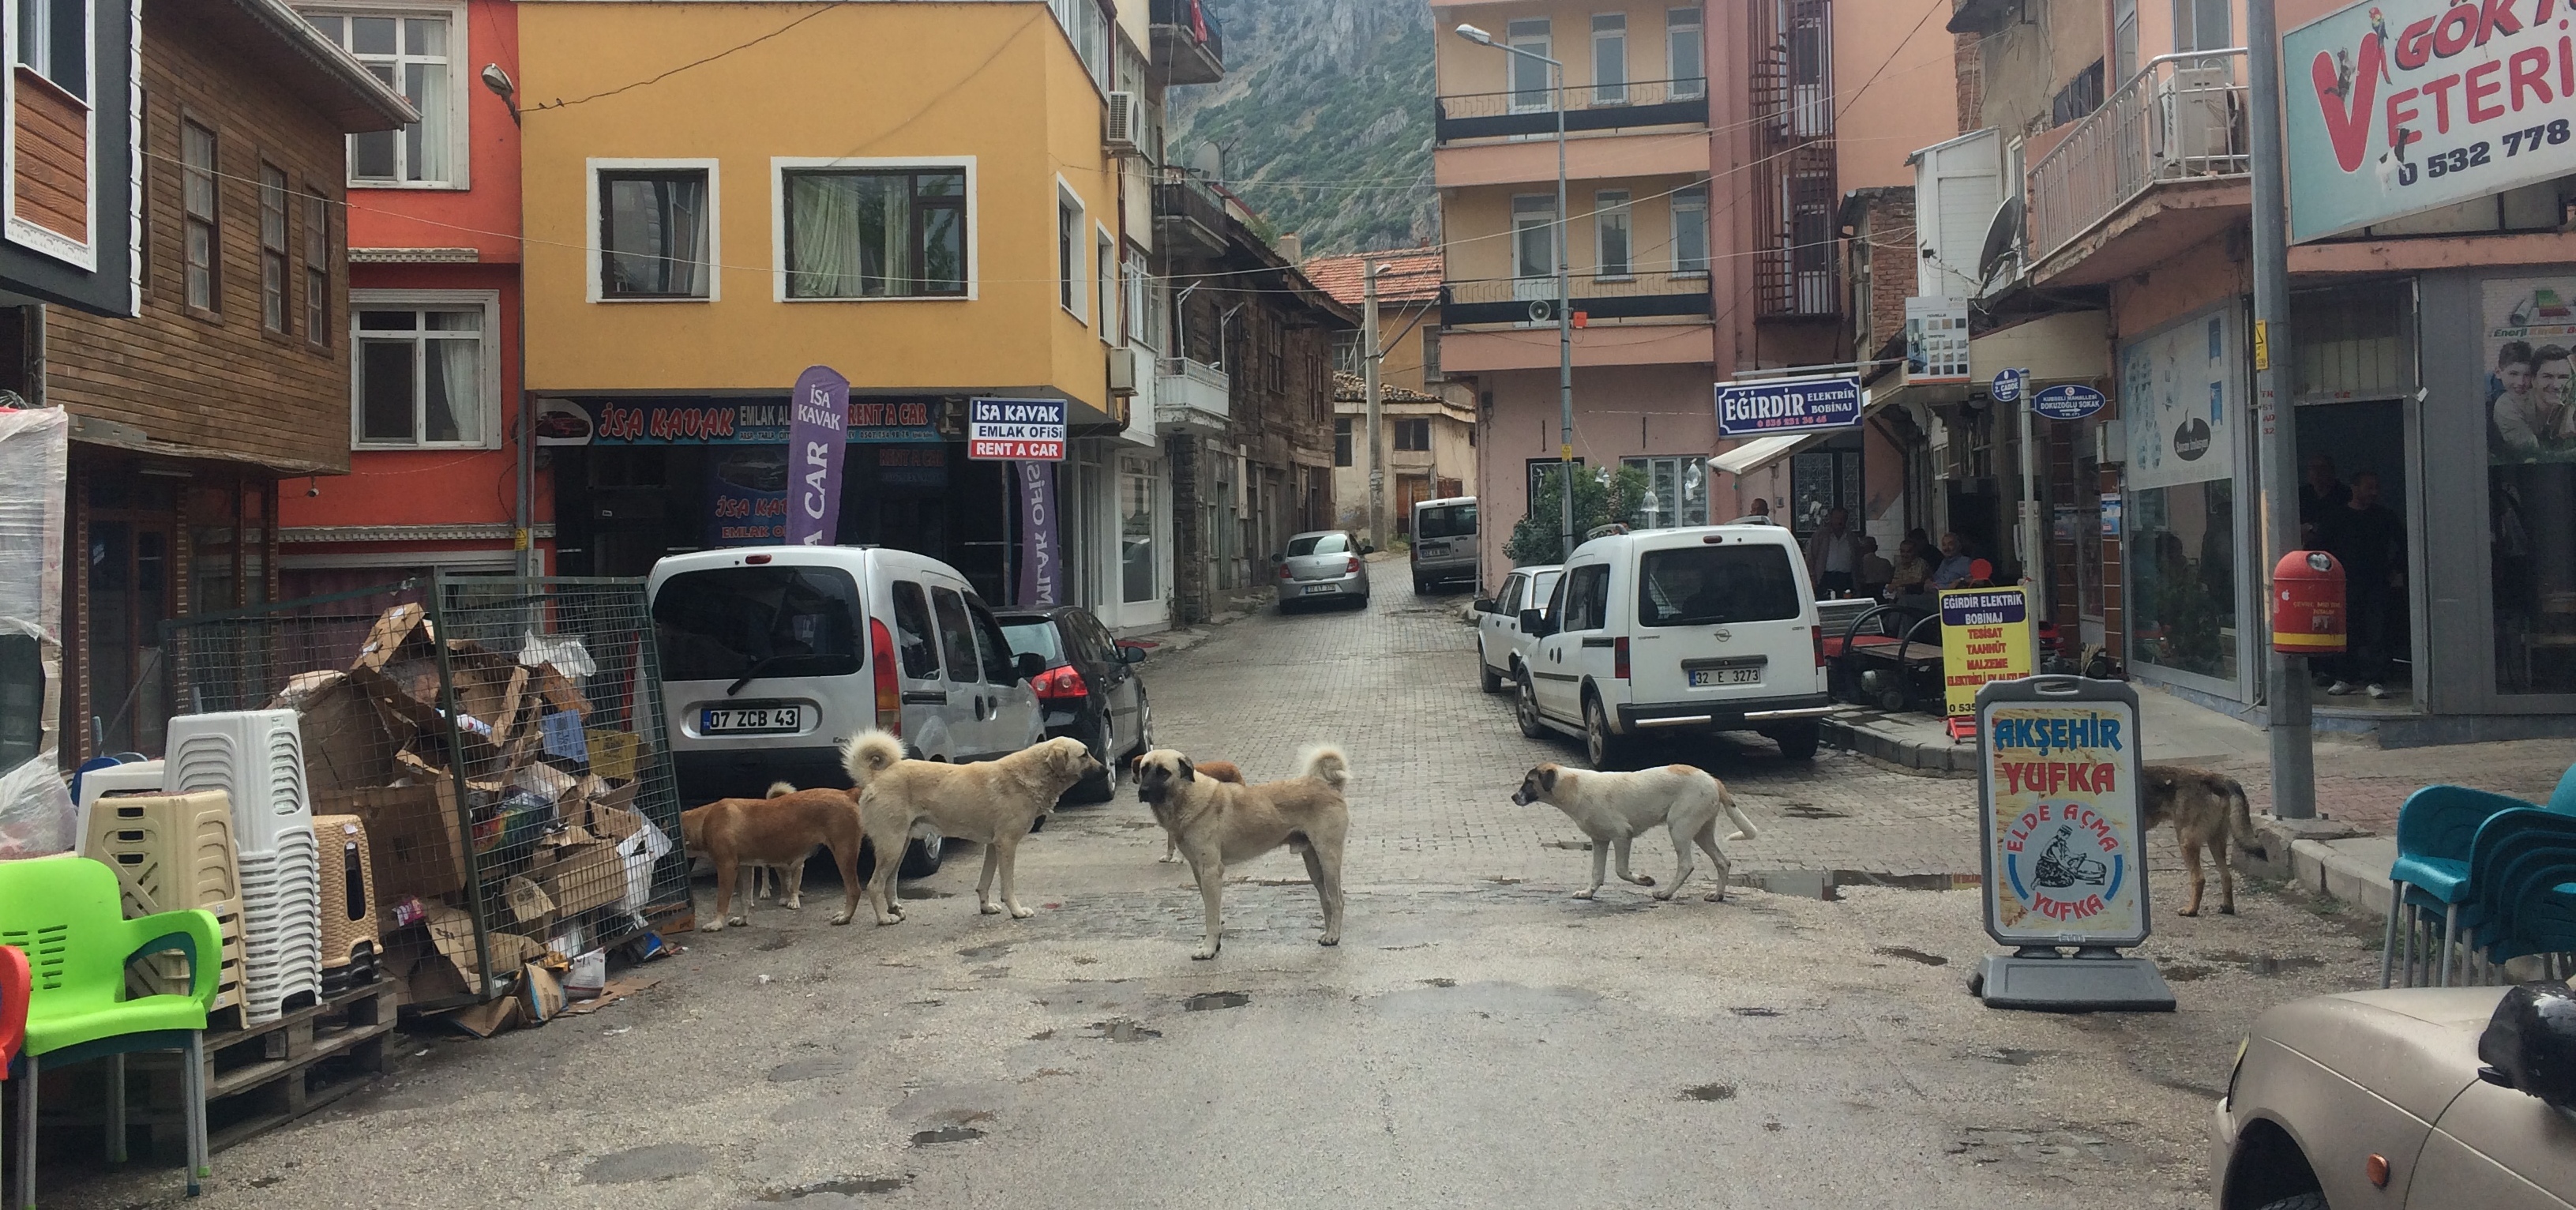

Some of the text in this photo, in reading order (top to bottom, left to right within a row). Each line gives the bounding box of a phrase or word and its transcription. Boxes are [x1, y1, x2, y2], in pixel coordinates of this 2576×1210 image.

[2395, 0, 2576, 70] GÖK
[2399, 118, 2570, 186] 0 532 778
[810, 384, 831, 408] İSA
[1724, 387, 1805, 421] EĞİRDİR
[2078, 400, 2100, 408] SOKAK
[798, 404, 841, 430] KAVAK
[976, 400, 1060, 422] İSA KAVAK
[1811, 402, 1853, 415] BOBİNAJ
[599, 402, 644, 441] İSA
[650, 408, 735, 441] KAVAK
[740, 405, 775, 426] EMLAK
[848, 404, 884, 426] RENT
[885, 404, 898, 426] A
[899, 404, 928, 426] CAR
[979, 425, 1025, 438] EMLAK
[976, 442, 1058, 457] RENT A CAR
[804, 442, 828, 519] CAR
[715, 495, 750, 519] İSA
[722, 524, 787, 539] EMLAK O
[1943, 591, 2023, 610] EĞİRDİR ELEKTRİK
[1965, 610, 2003, 625] BOBİNAJ
[1966, 626, 2003, 640] TESİSAT
[1966, 641, 2007, 655] TAAHHÜT
[1966, 658, 2009, 671] MALZEME
[1695, 670, 1759, 684] 32 E 3273
[711, 712, 730, 728] 07
[737, 712, 768, 727] ZCB
[775, 710, 796, 726] 43
[1949, 705, 1956, 713] 0
[1994, 712, 2123, 756] AKŞEHİR
[2002, 762, 2116, 795] YUFKA
[2007, 804, 2120, 852] ELDE AÇMA
[2032, 892, 2105, 922] YUFKA
